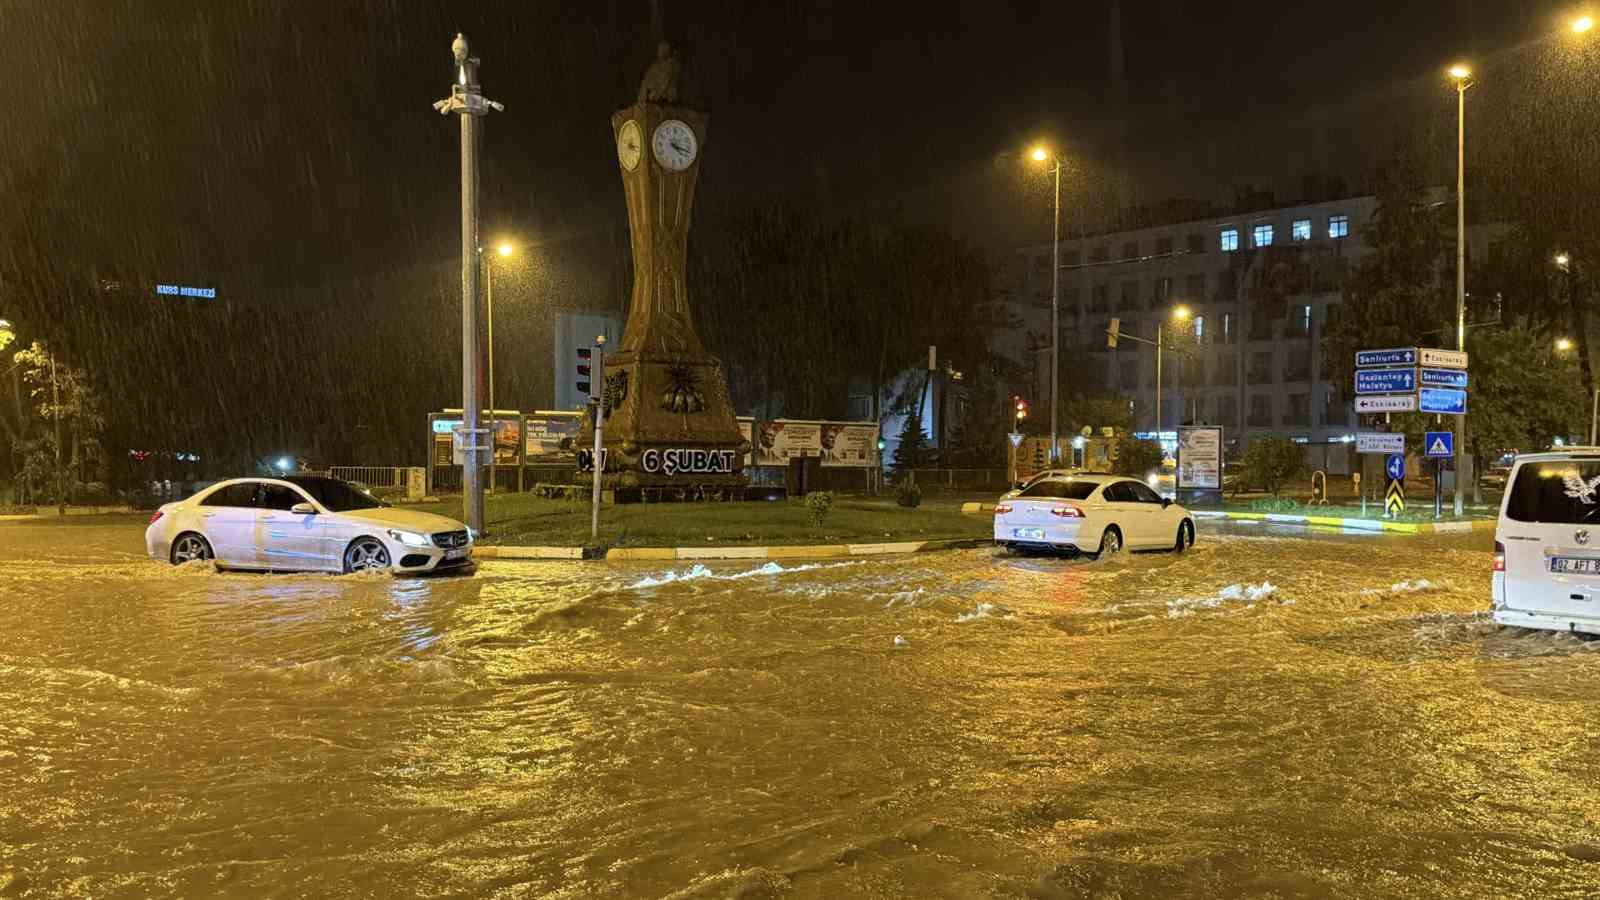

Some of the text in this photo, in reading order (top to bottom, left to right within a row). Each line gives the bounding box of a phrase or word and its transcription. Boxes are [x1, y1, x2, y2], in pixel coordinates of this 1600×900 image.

[157, 284, 215, 298] KURS MERKEZİ
[642, 449, 735, 476] 6 ŞUBAT
[1558, 559, 1569, 569] 02
